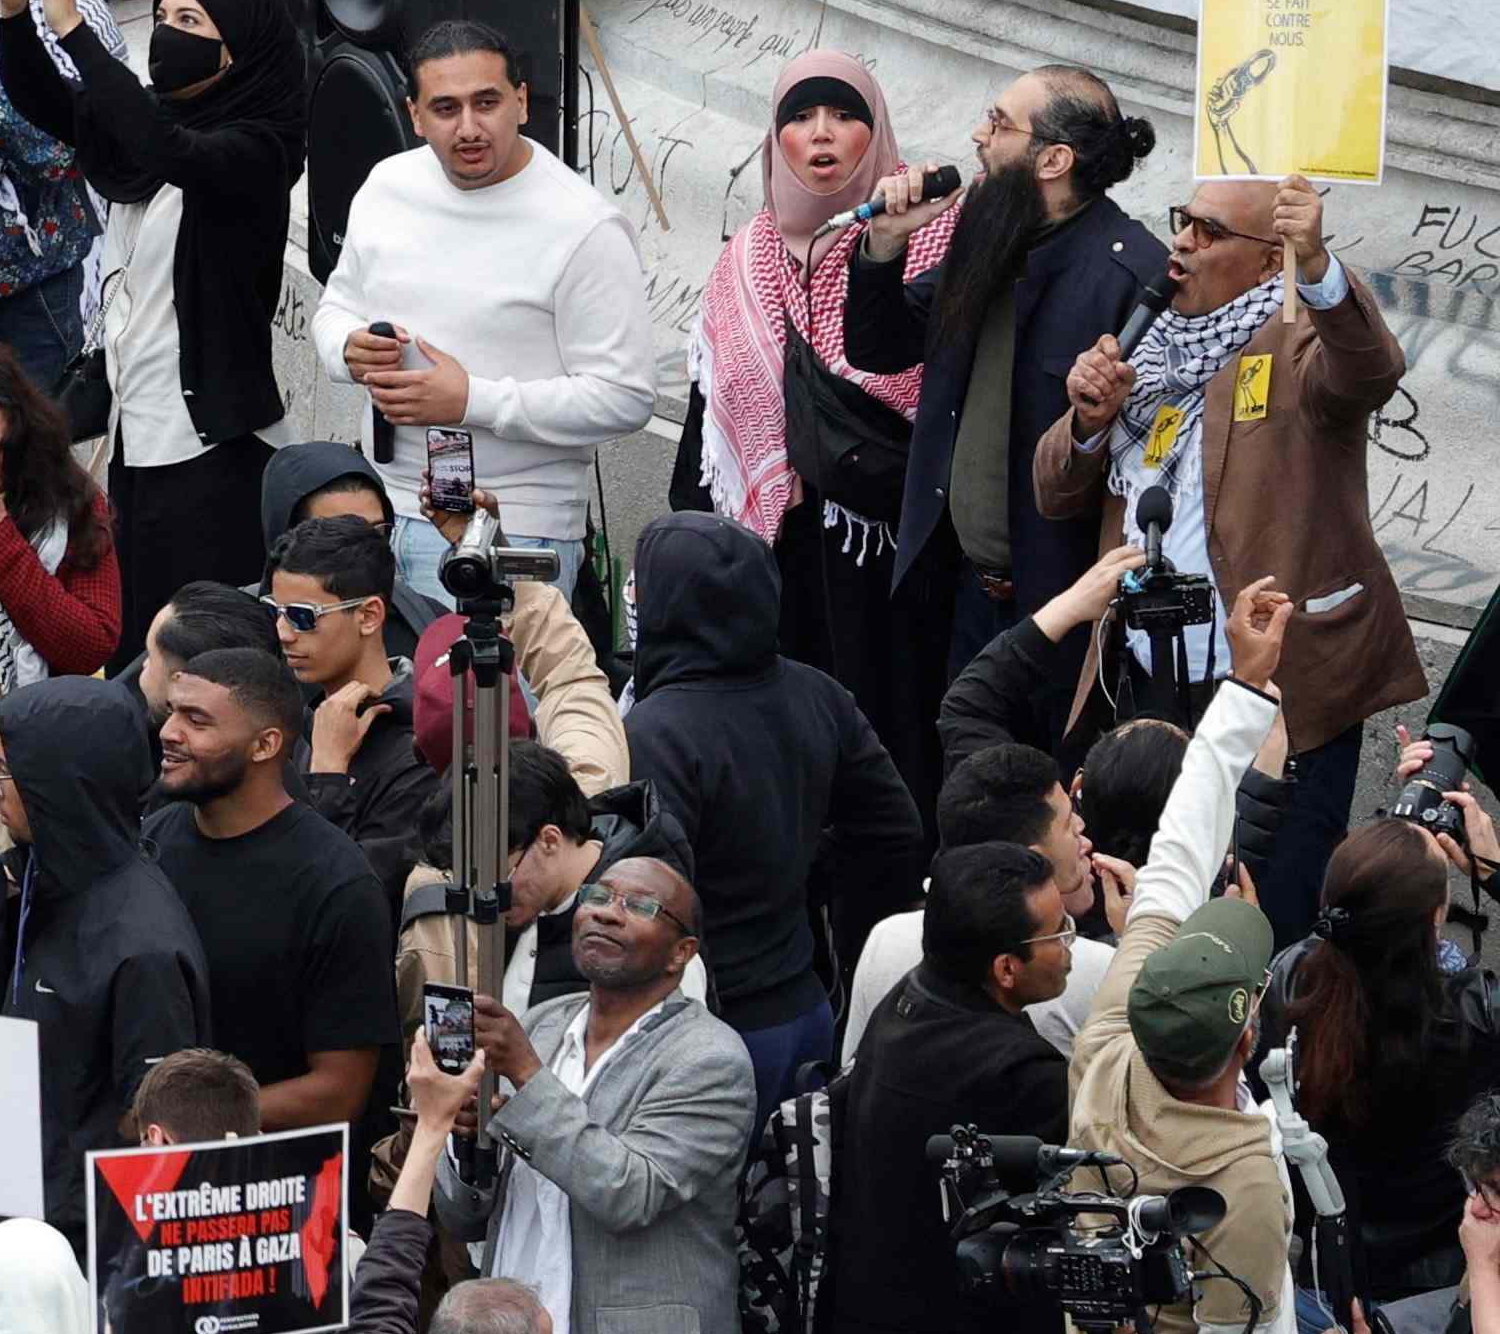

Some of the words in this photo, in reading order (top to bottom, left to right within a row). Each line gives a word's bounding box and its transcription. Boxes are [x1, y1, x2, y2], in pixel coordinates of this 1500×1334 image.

[1266, 13, 1312, 28] CONTRE
[135, 1182, 241, 1222] L'EXTRÊME
[246, 1175, 306, 1210] DROITE
[159, 1221, 183, 1246] NE
[186, 1215, 257, 1243] PASSERA
[260, 1208, 291, 1234] PAS
[147, 1247, 175, 1278] DE
[177, 1241, 234, 1274] PARIS
[238, 1234, 253, 1268] À
[256, 1233, 302, 1265] GAZA
[182, 1270, 265, 1304] INTIFADA
[268, 1269, 277, 1294] !
